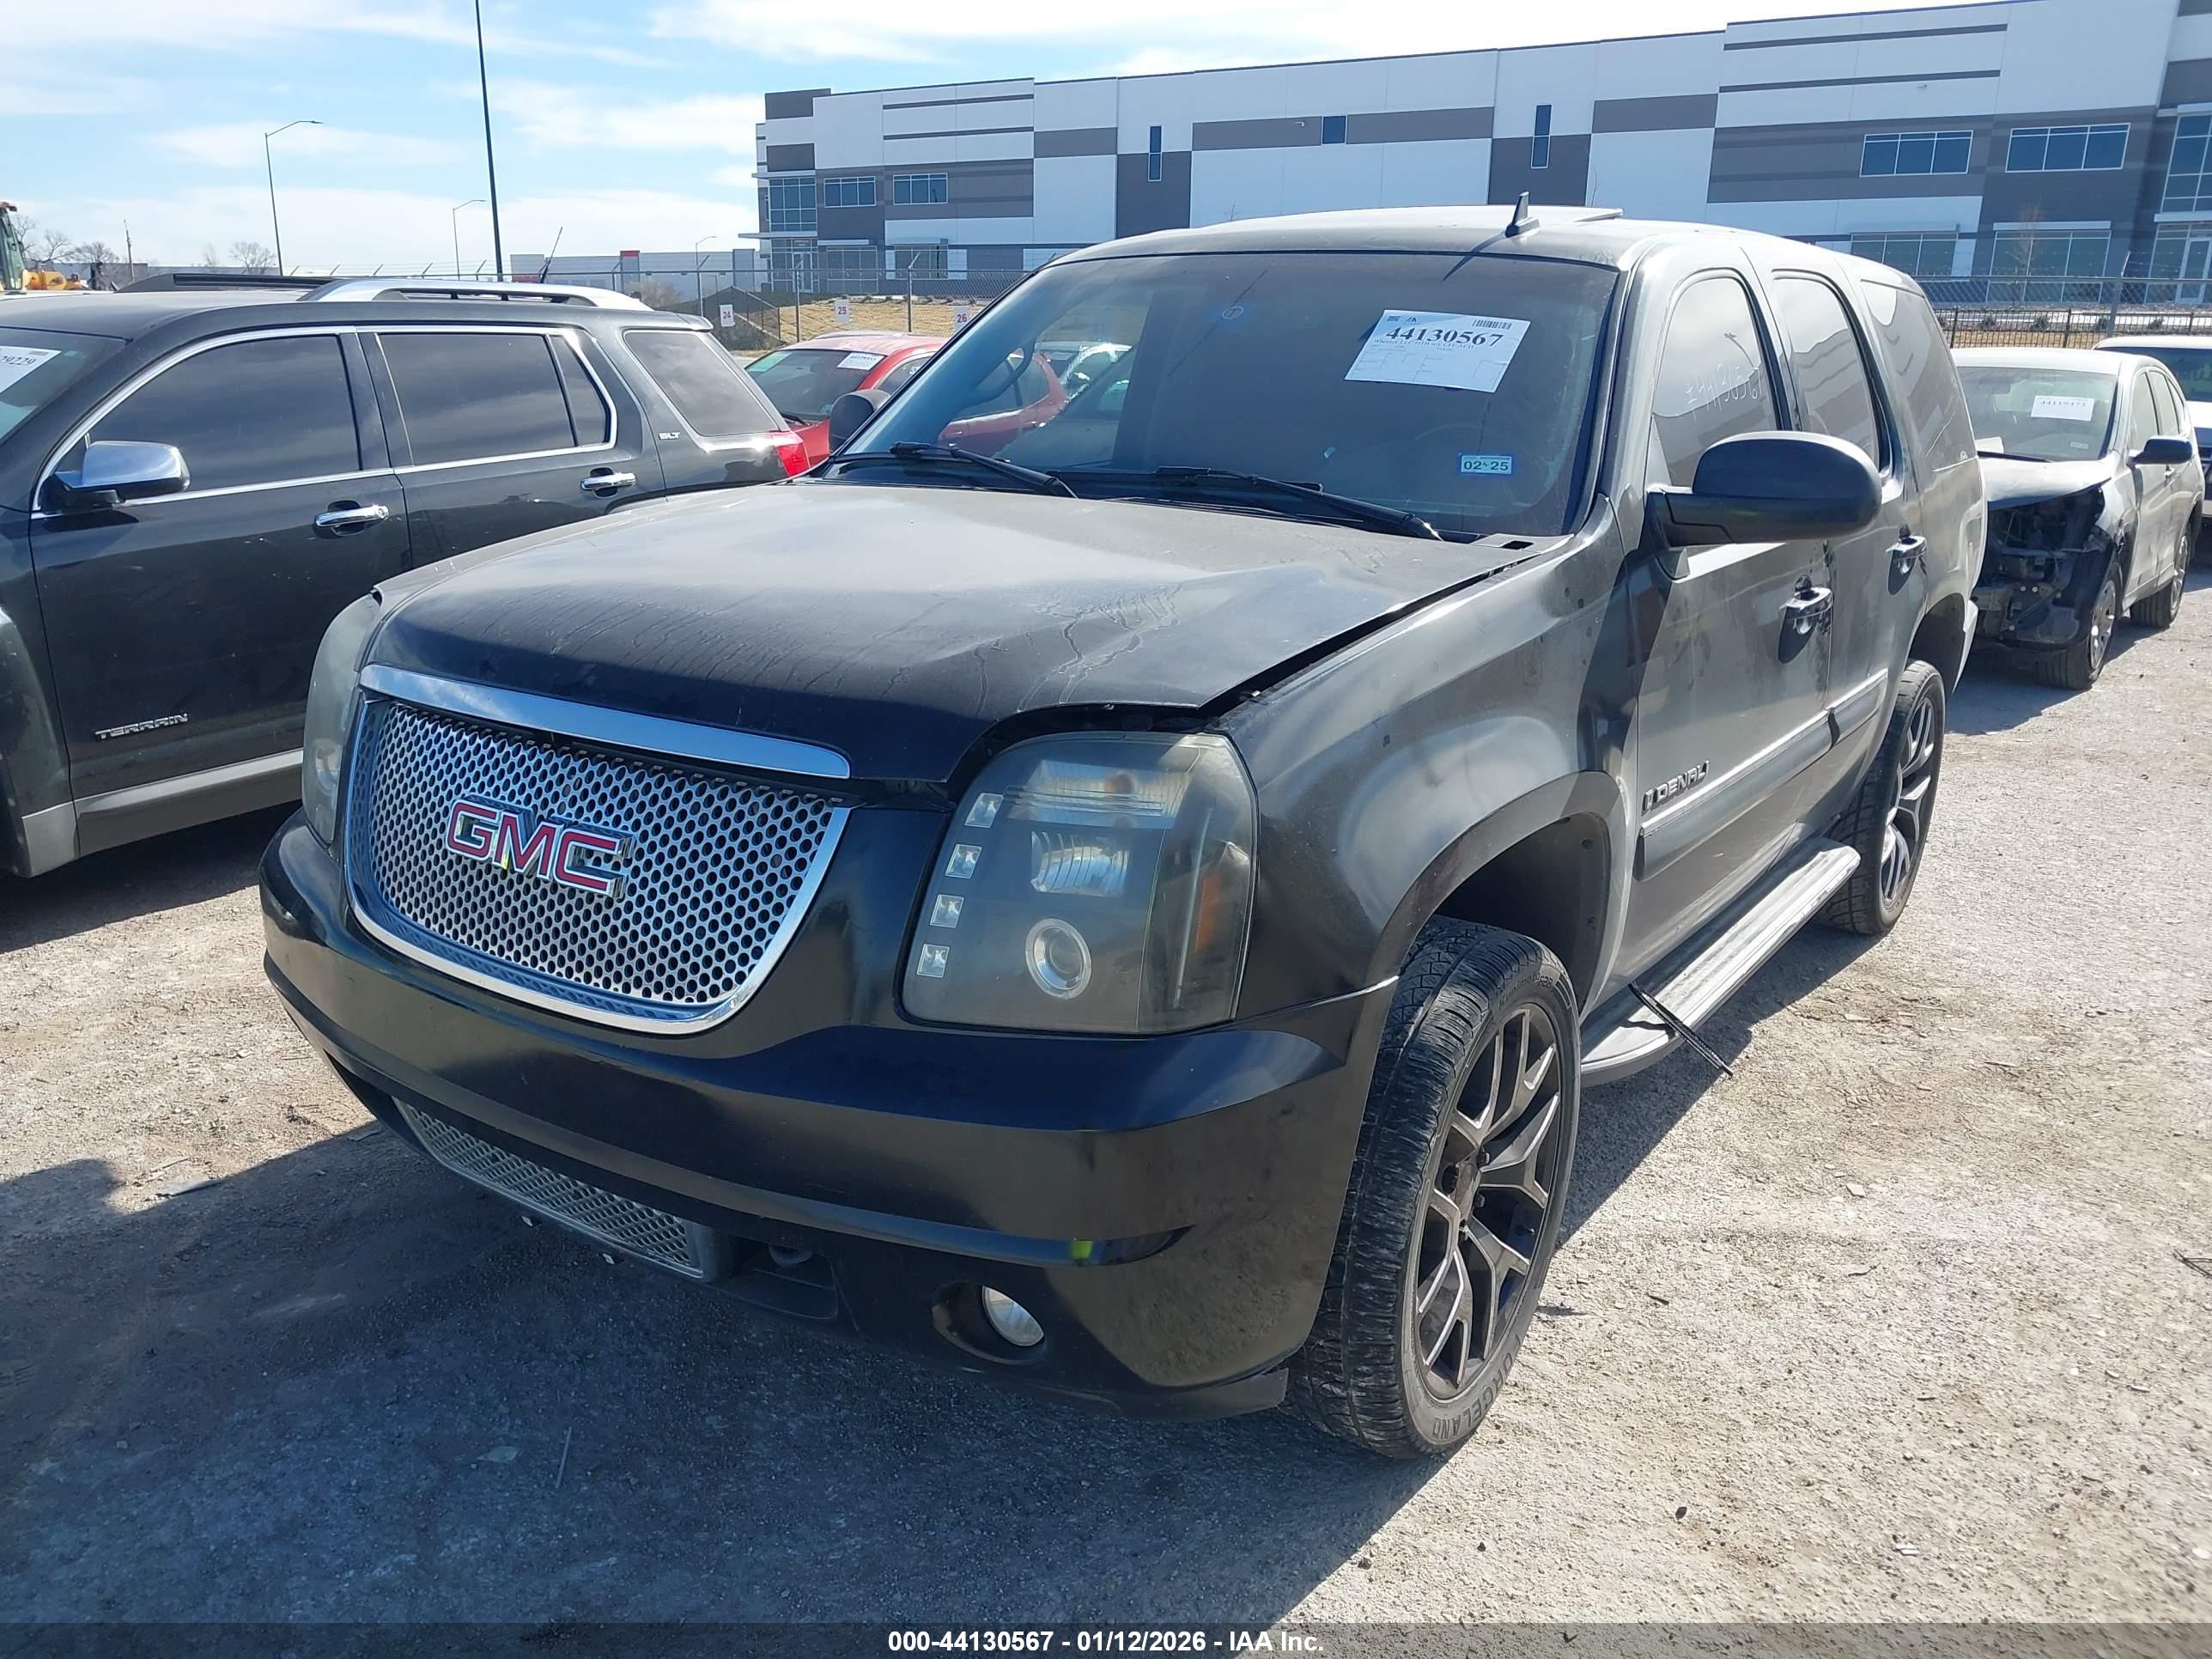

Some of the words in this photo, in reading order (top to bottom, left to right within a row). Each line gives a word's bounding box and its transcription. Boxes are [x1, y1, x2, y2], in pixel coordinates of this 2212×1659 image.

[722, 310, 731, 319] 24
[837, 306, 847, 315] 25
[957, 313, 967, 323] 26
[1386, 326, 1504, 347] 44130567
[1463, 460, 1482, 470] 02
[1490, 461, 1509, 471] 25
[94, 713, 188, 739] TERRAIN
[445, 795, 634, 898] GMC
